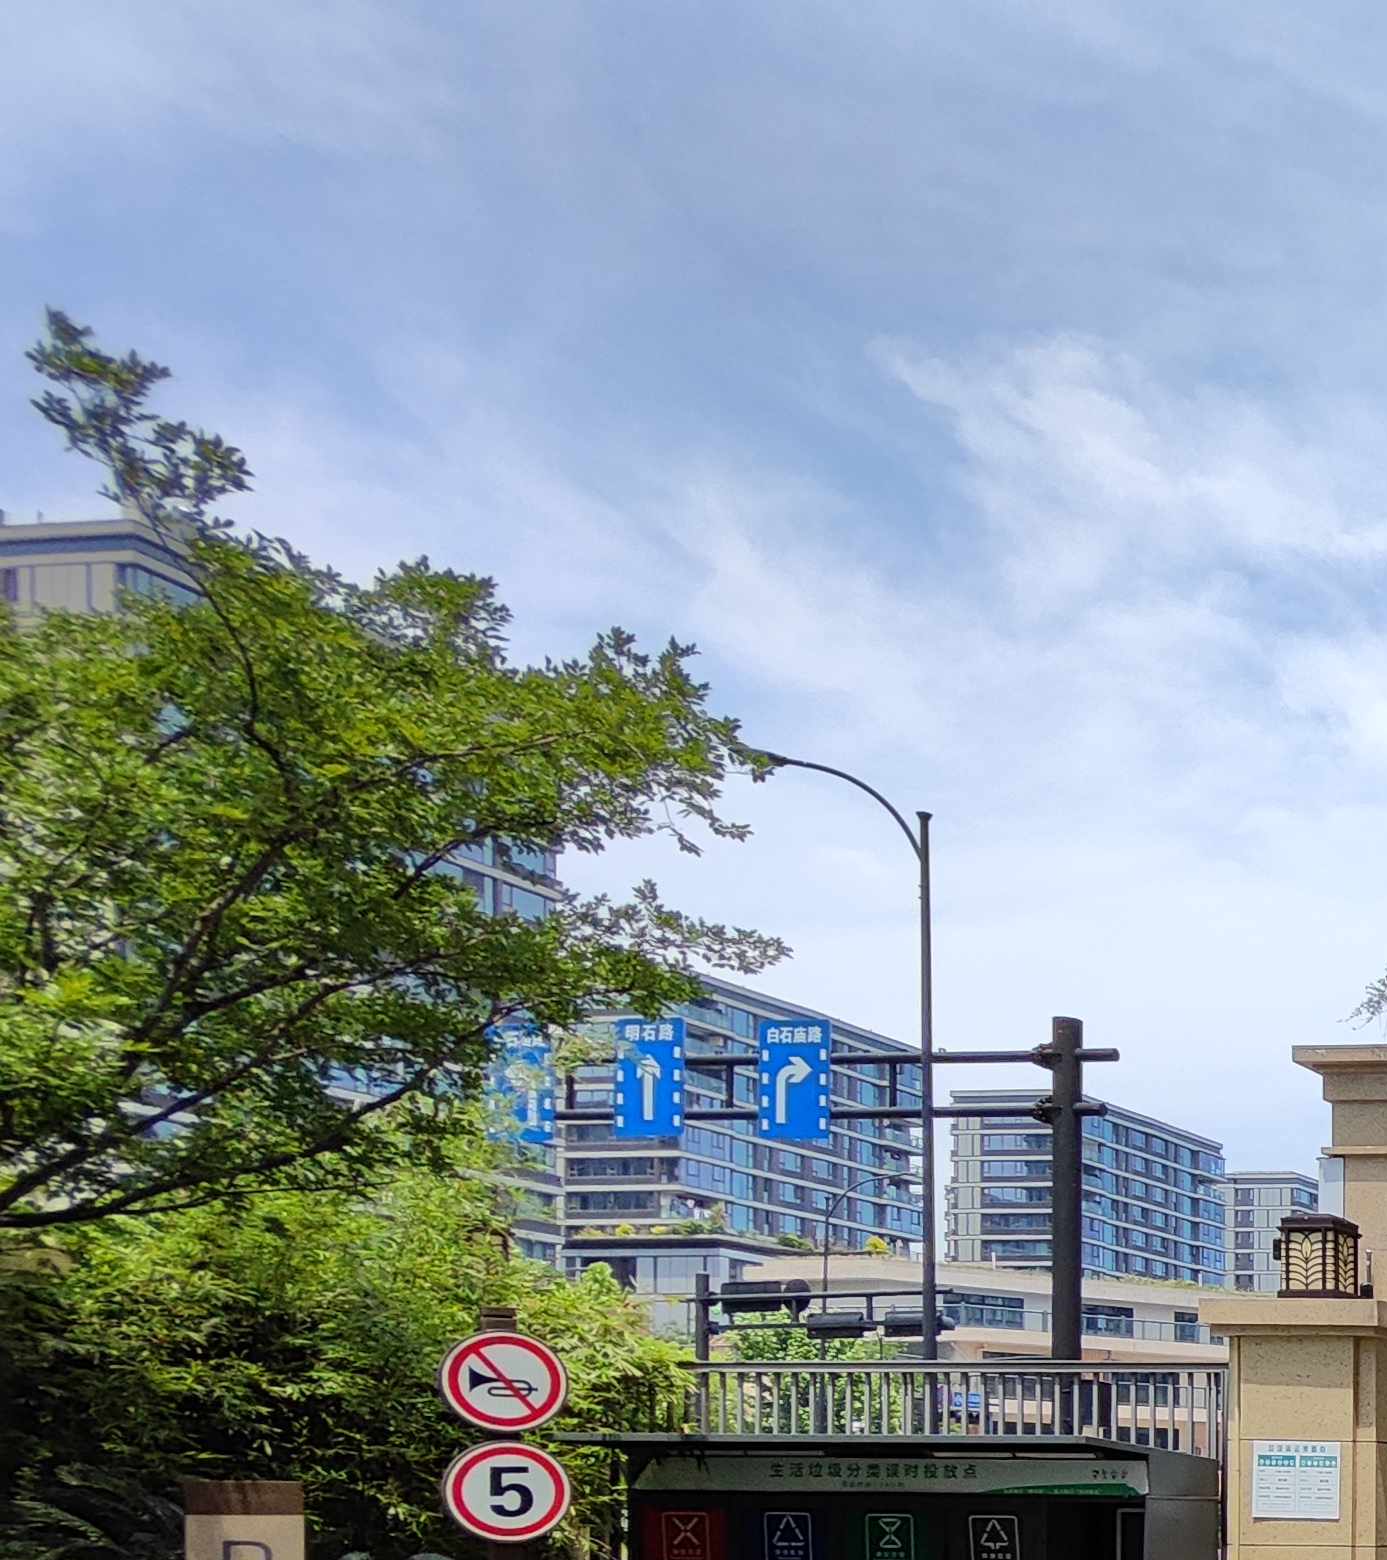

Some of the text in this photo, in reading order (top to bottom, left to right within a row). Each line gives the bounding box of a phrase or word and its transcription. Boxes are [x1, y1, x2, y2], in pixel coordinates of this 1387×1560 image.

[625, 1024, 674, 1041] 明石路
[766, 1026, 822, 1044] 白石庙路
[489, 1466, 534, 1517] 5
